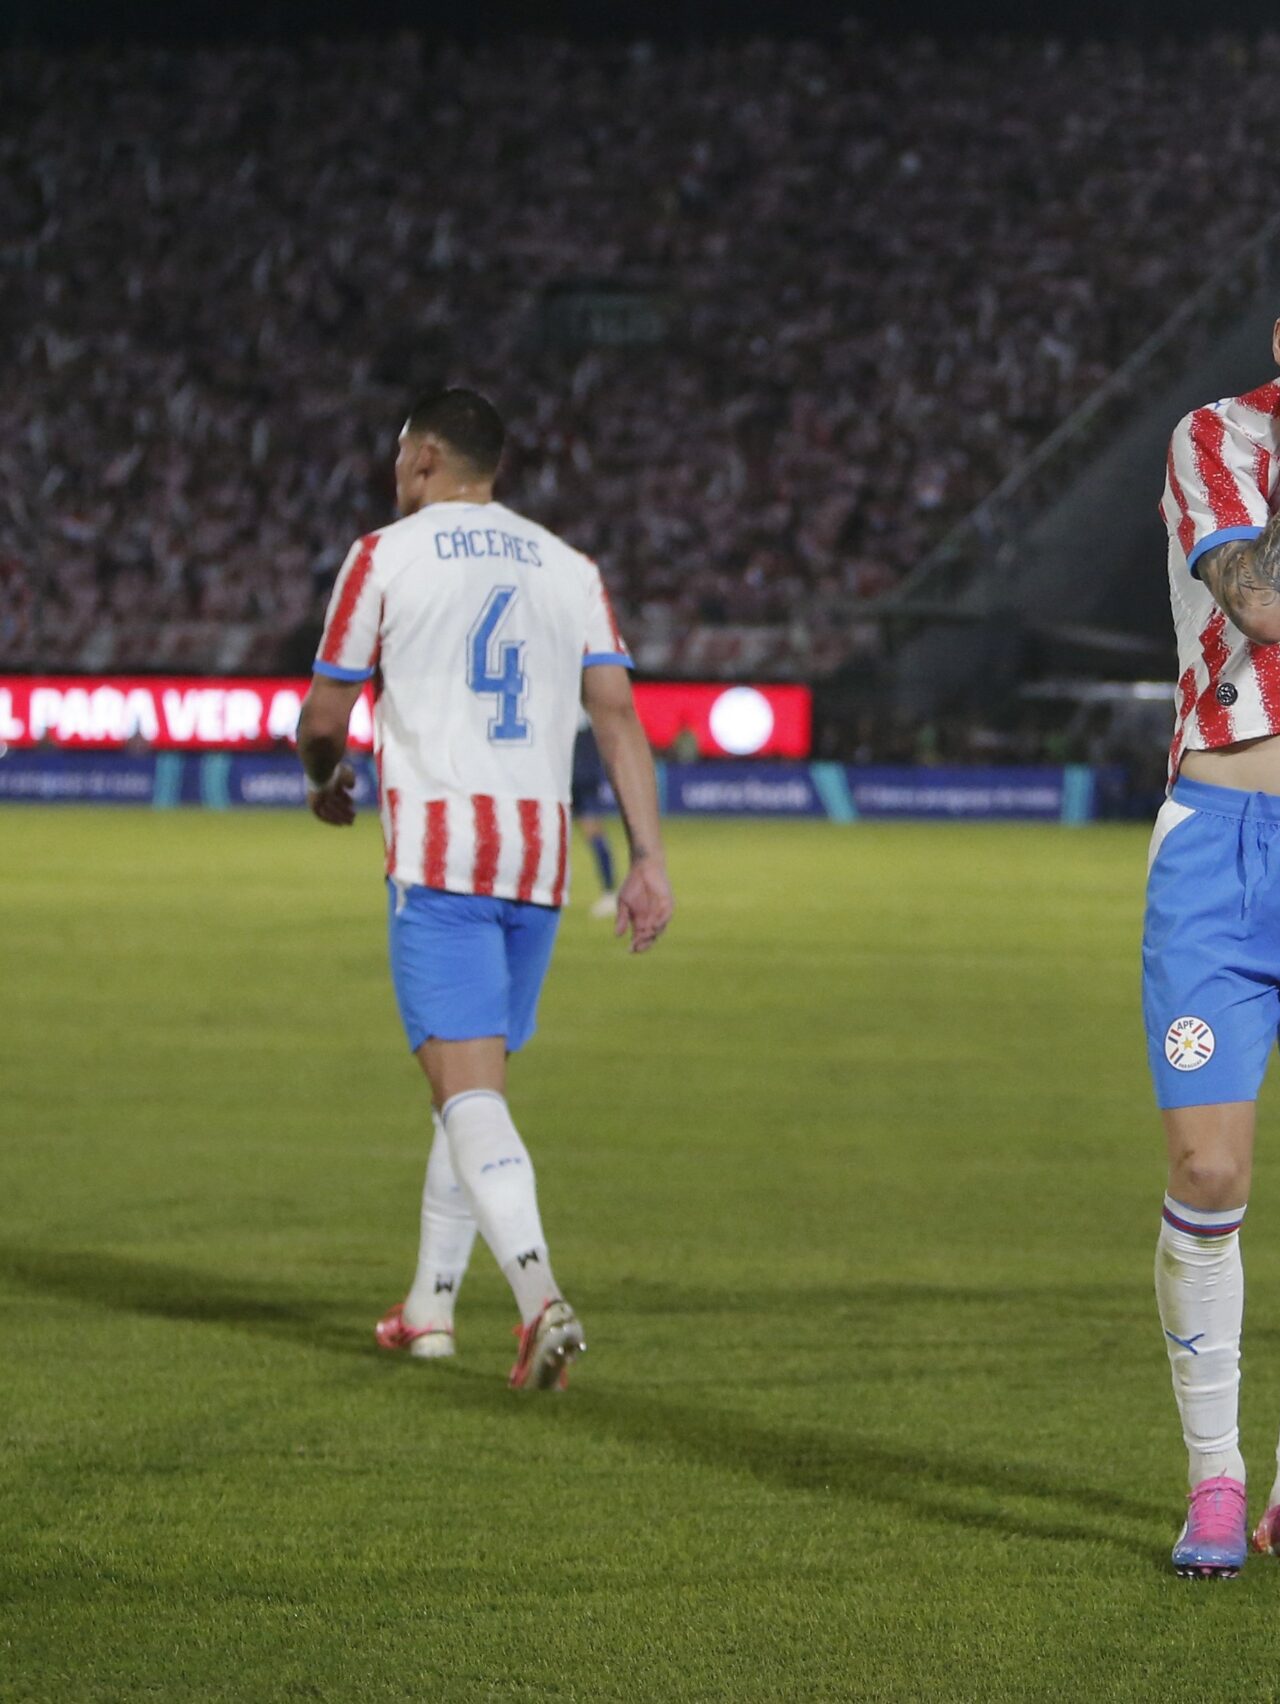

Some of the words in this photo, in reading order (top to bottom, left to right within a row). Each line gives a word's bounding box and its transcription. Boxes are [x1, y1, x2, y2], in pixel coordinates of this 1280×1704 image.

[434, 526, 542, 567] CÁCERES
[466, 585, 533, 747] 4
[30, 686, 159, 742] PARA
[162, 688, 262, 742] VER
[1176, 1018, 1194, 1031] APF
